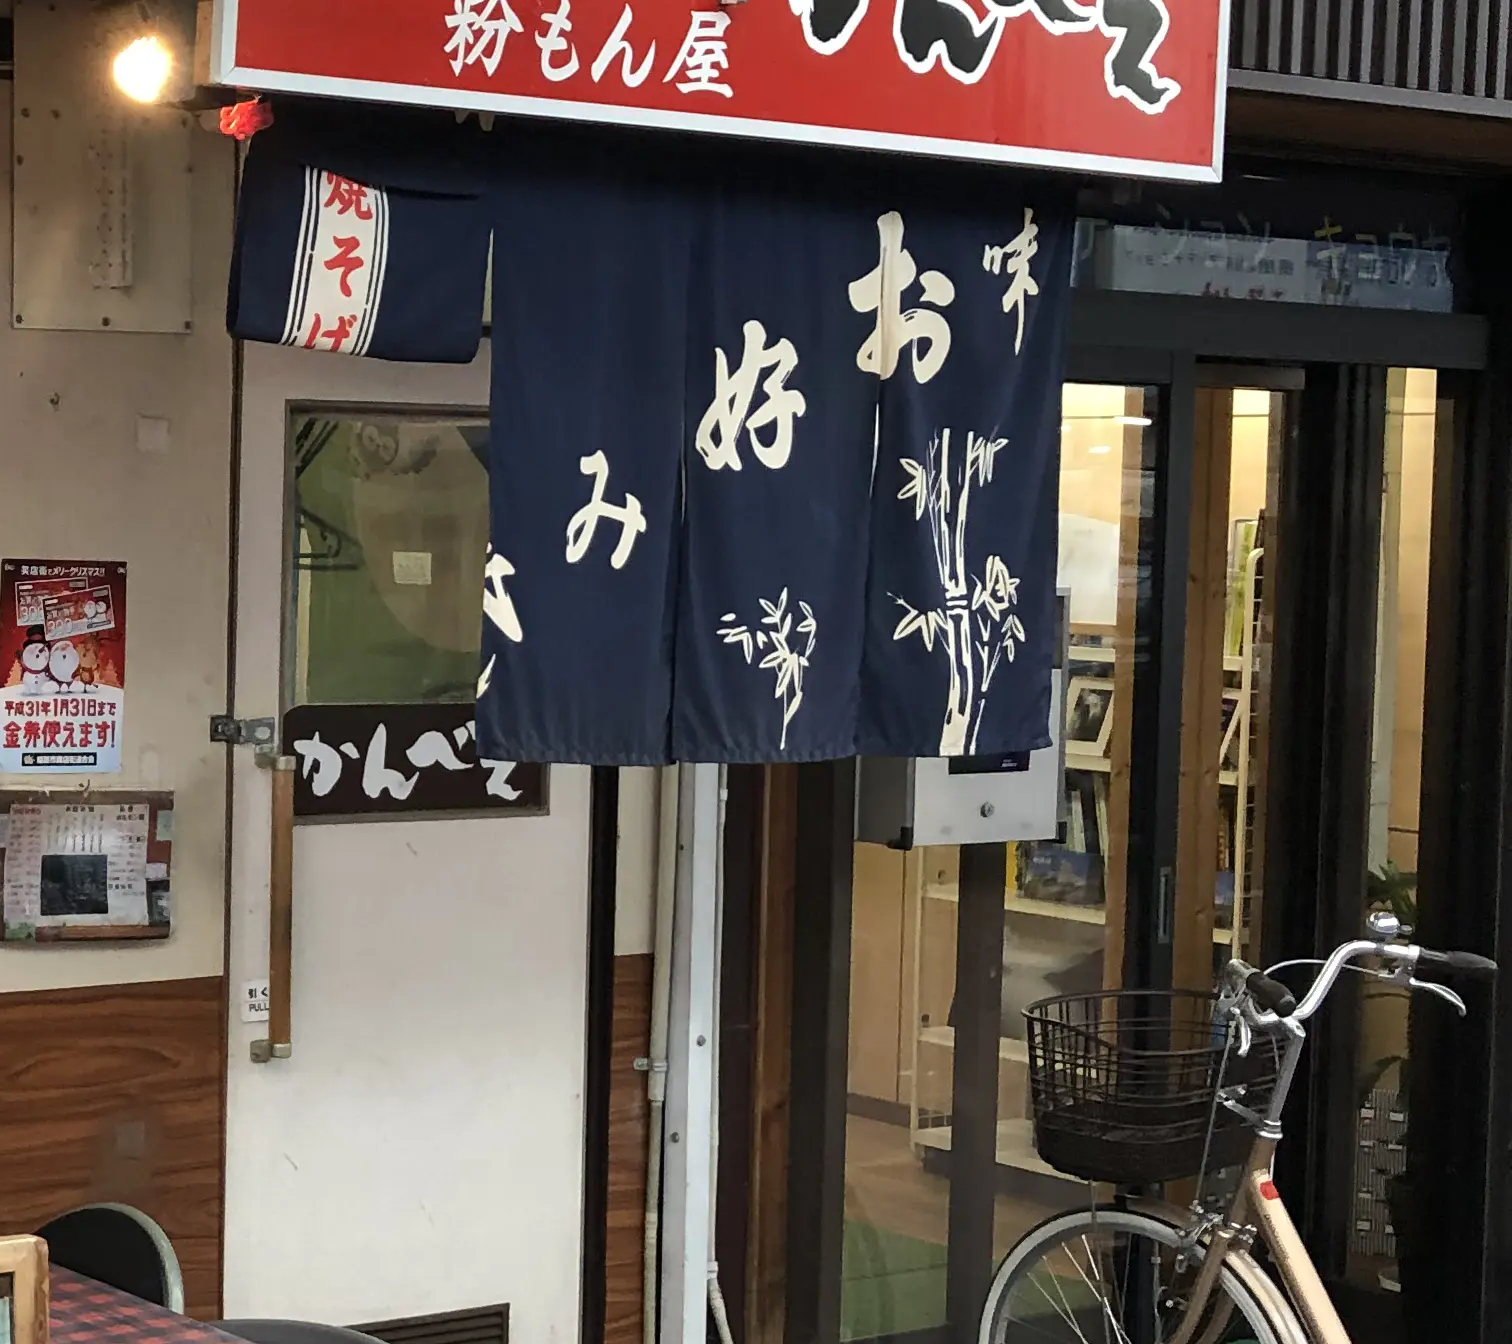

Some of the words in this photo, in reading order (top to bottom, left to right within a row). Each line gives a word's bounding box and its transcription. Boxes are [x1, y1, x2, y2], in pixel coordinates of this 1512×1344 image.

[982, 207, 1038, 356] 味
[4, 698, 117, 717] 平成31年1月31日まで
[248, 1003, 269, 1012] PULL
